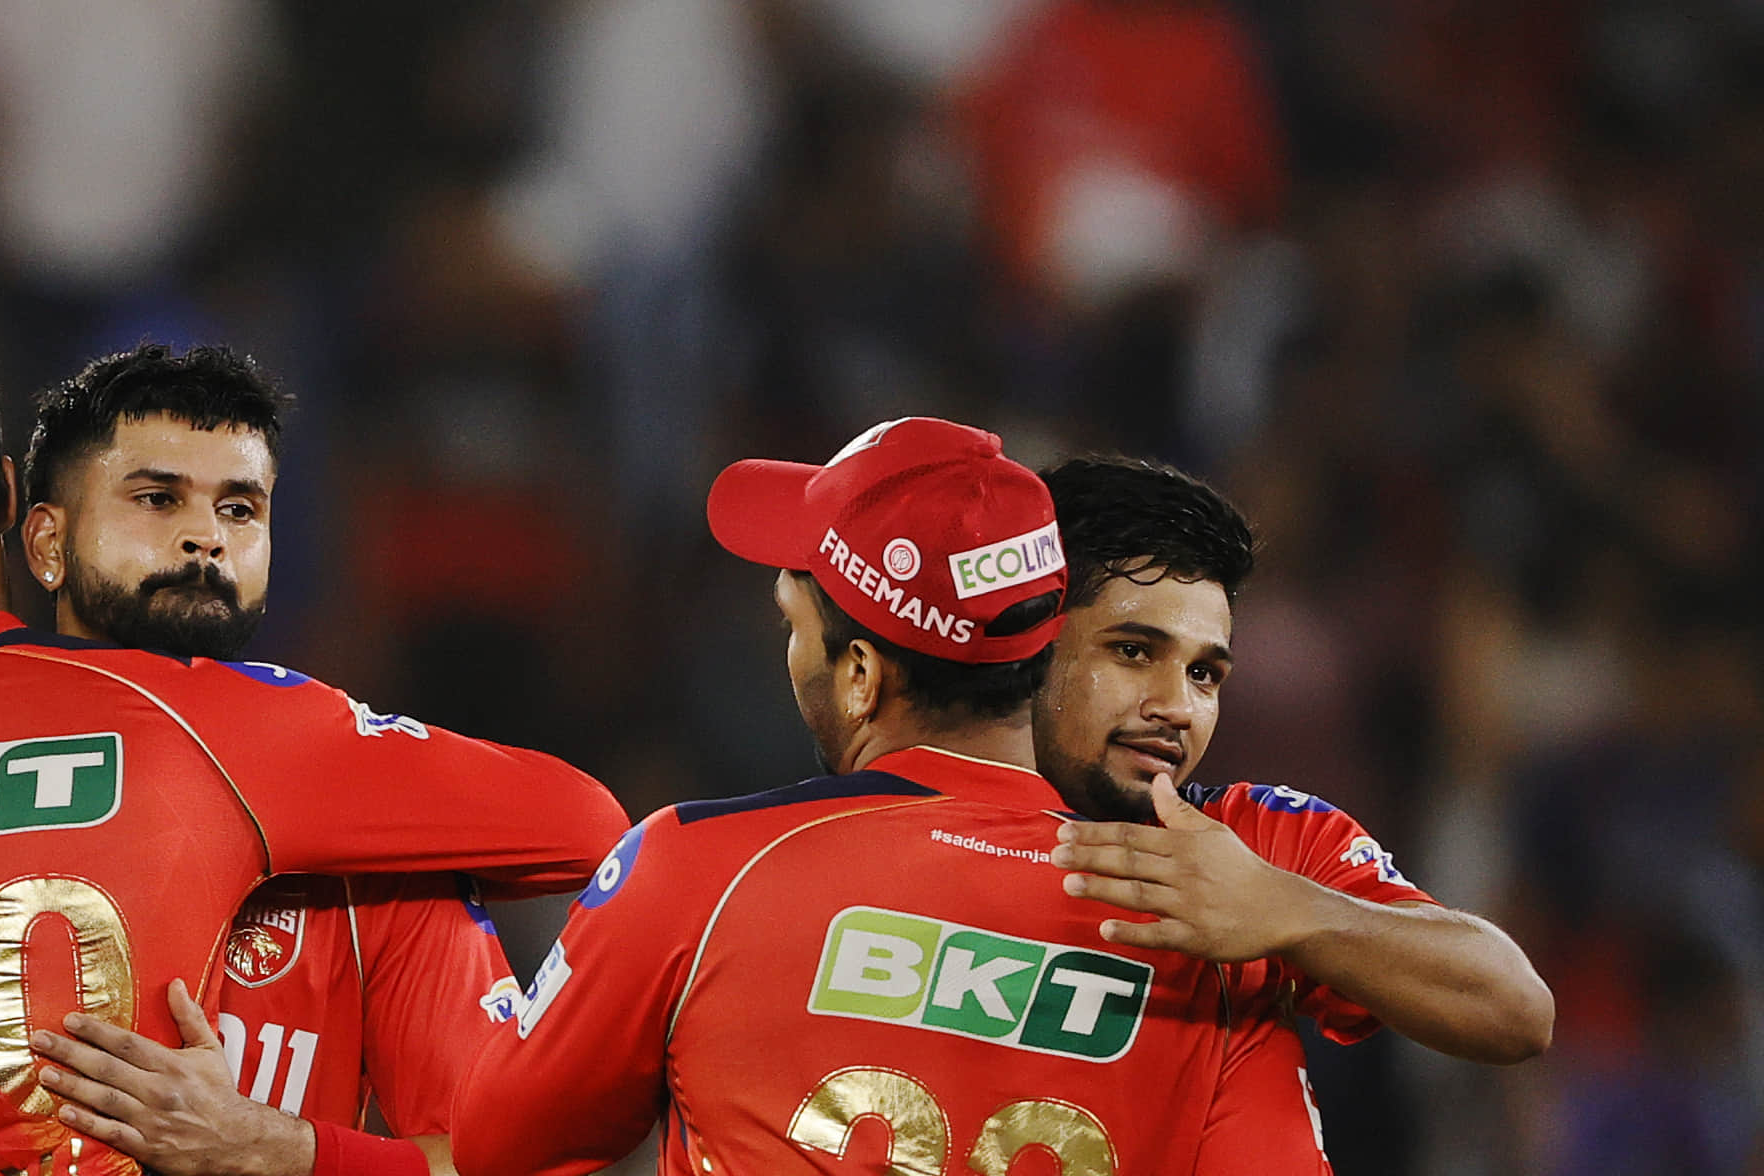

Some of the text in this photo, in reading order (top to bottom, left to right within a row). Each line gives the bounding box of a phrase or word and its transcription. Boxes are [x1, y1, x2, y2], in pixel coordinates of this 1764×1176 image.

[818, 526, 976, 645] FREEMANS
[930, 828, 1051, 864] #saddapunja
[827, 928, 1135, 1037] BKT
